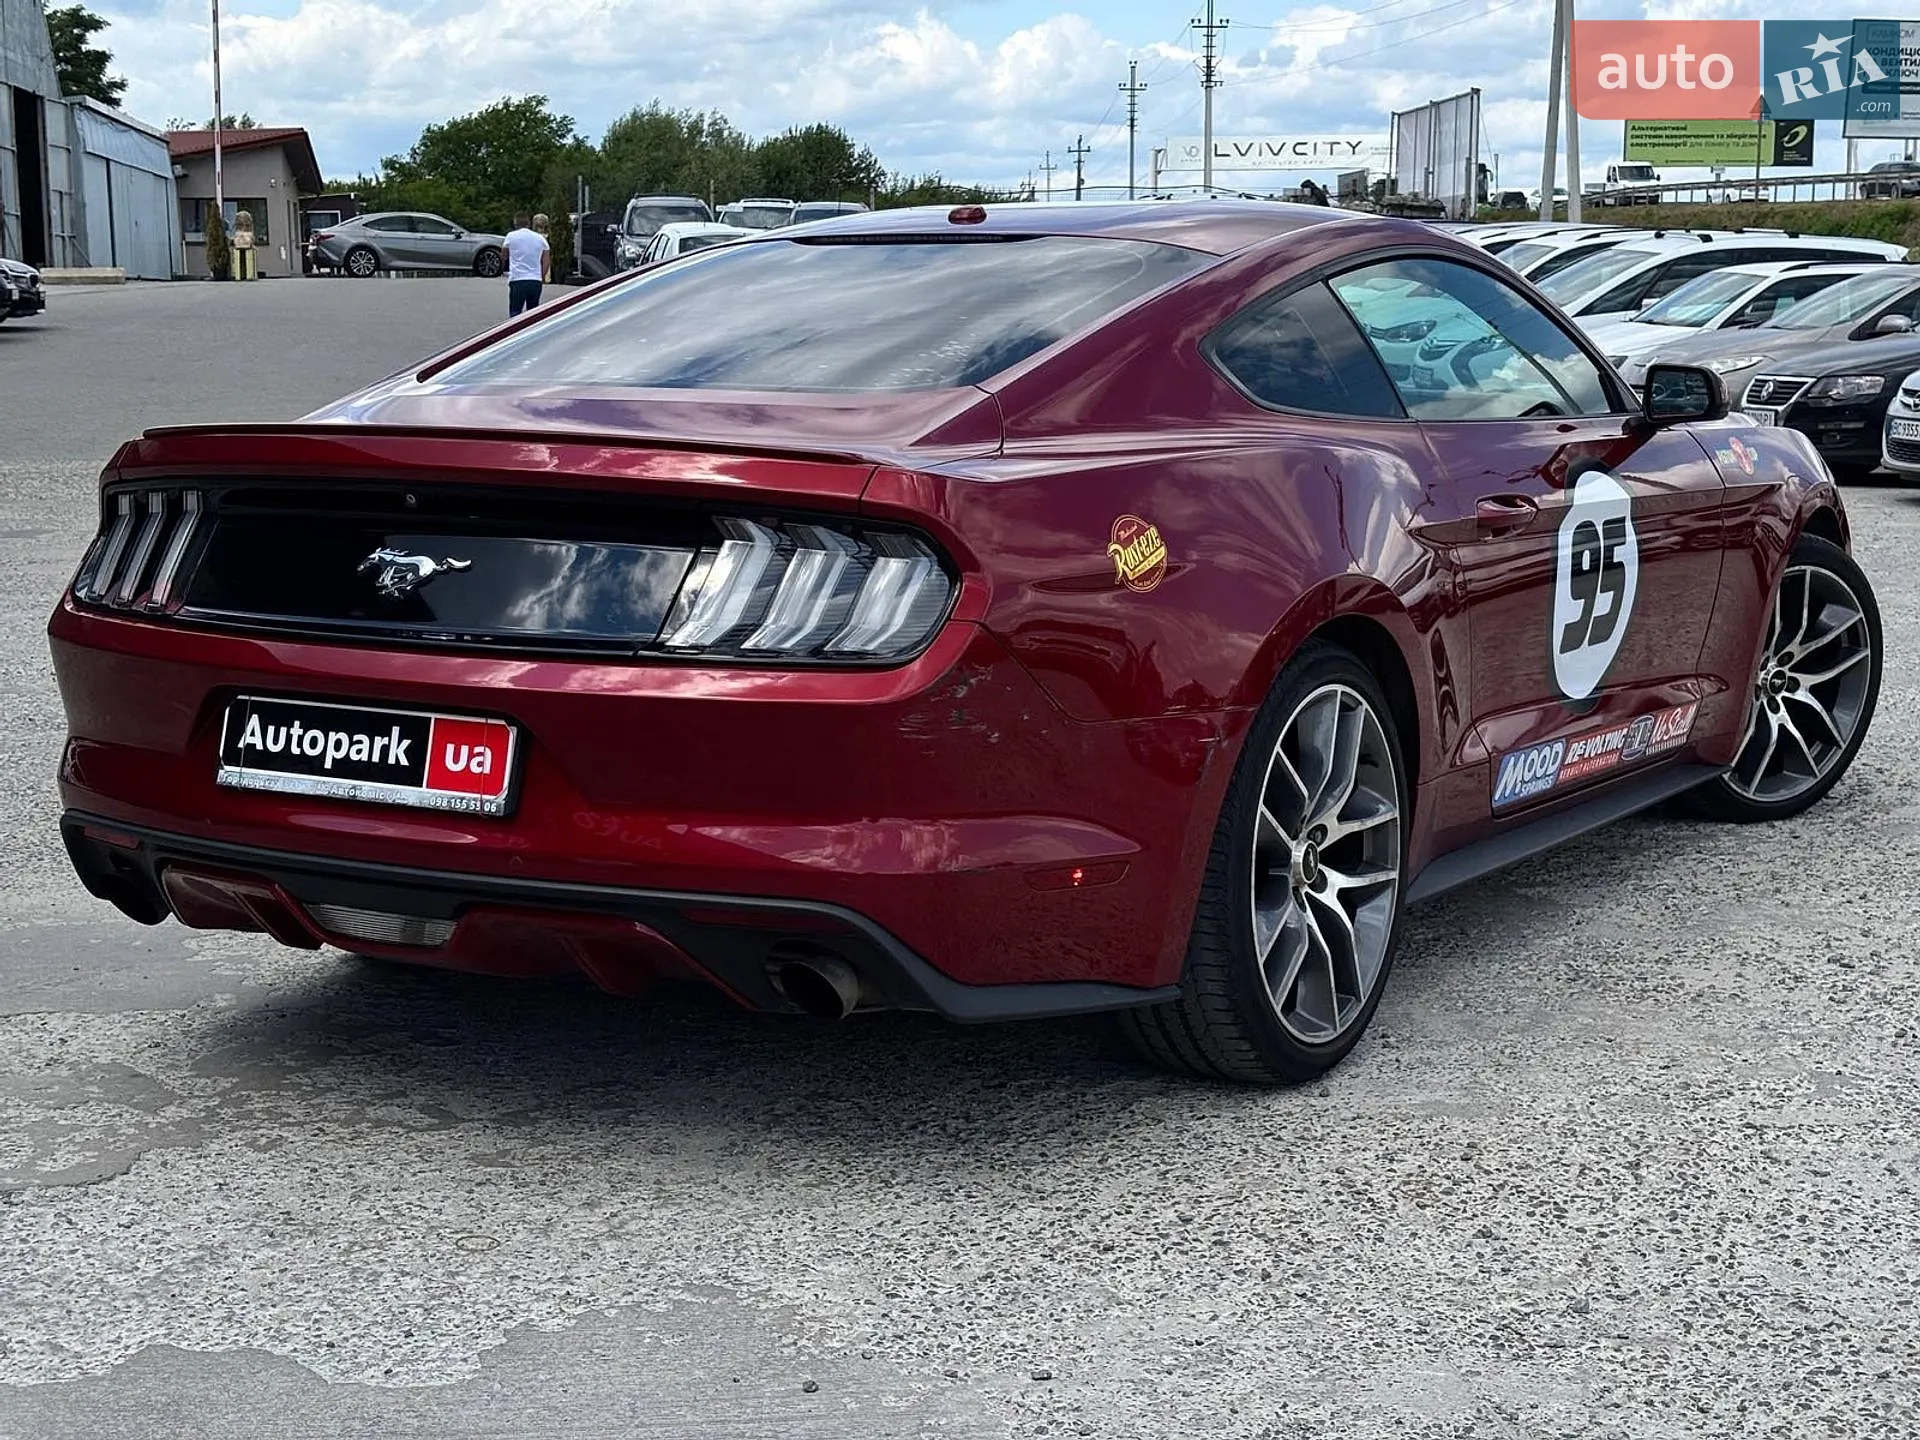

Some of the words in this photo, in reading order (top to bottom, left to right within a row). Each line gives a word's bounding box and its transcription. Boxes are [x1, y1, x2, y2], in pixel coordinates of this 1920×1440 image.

[1214, 140, 1363, 157] LVIVCITY
[1559, 515, 1626, 655] 95
[237, 713, 413, 769] Autopark
[444, 742, 493, 775] ua
[1494, 742, 1563, 801] MOOD
[450, 798, 467, 809] 155
[484, 802, 497, 813] 06
